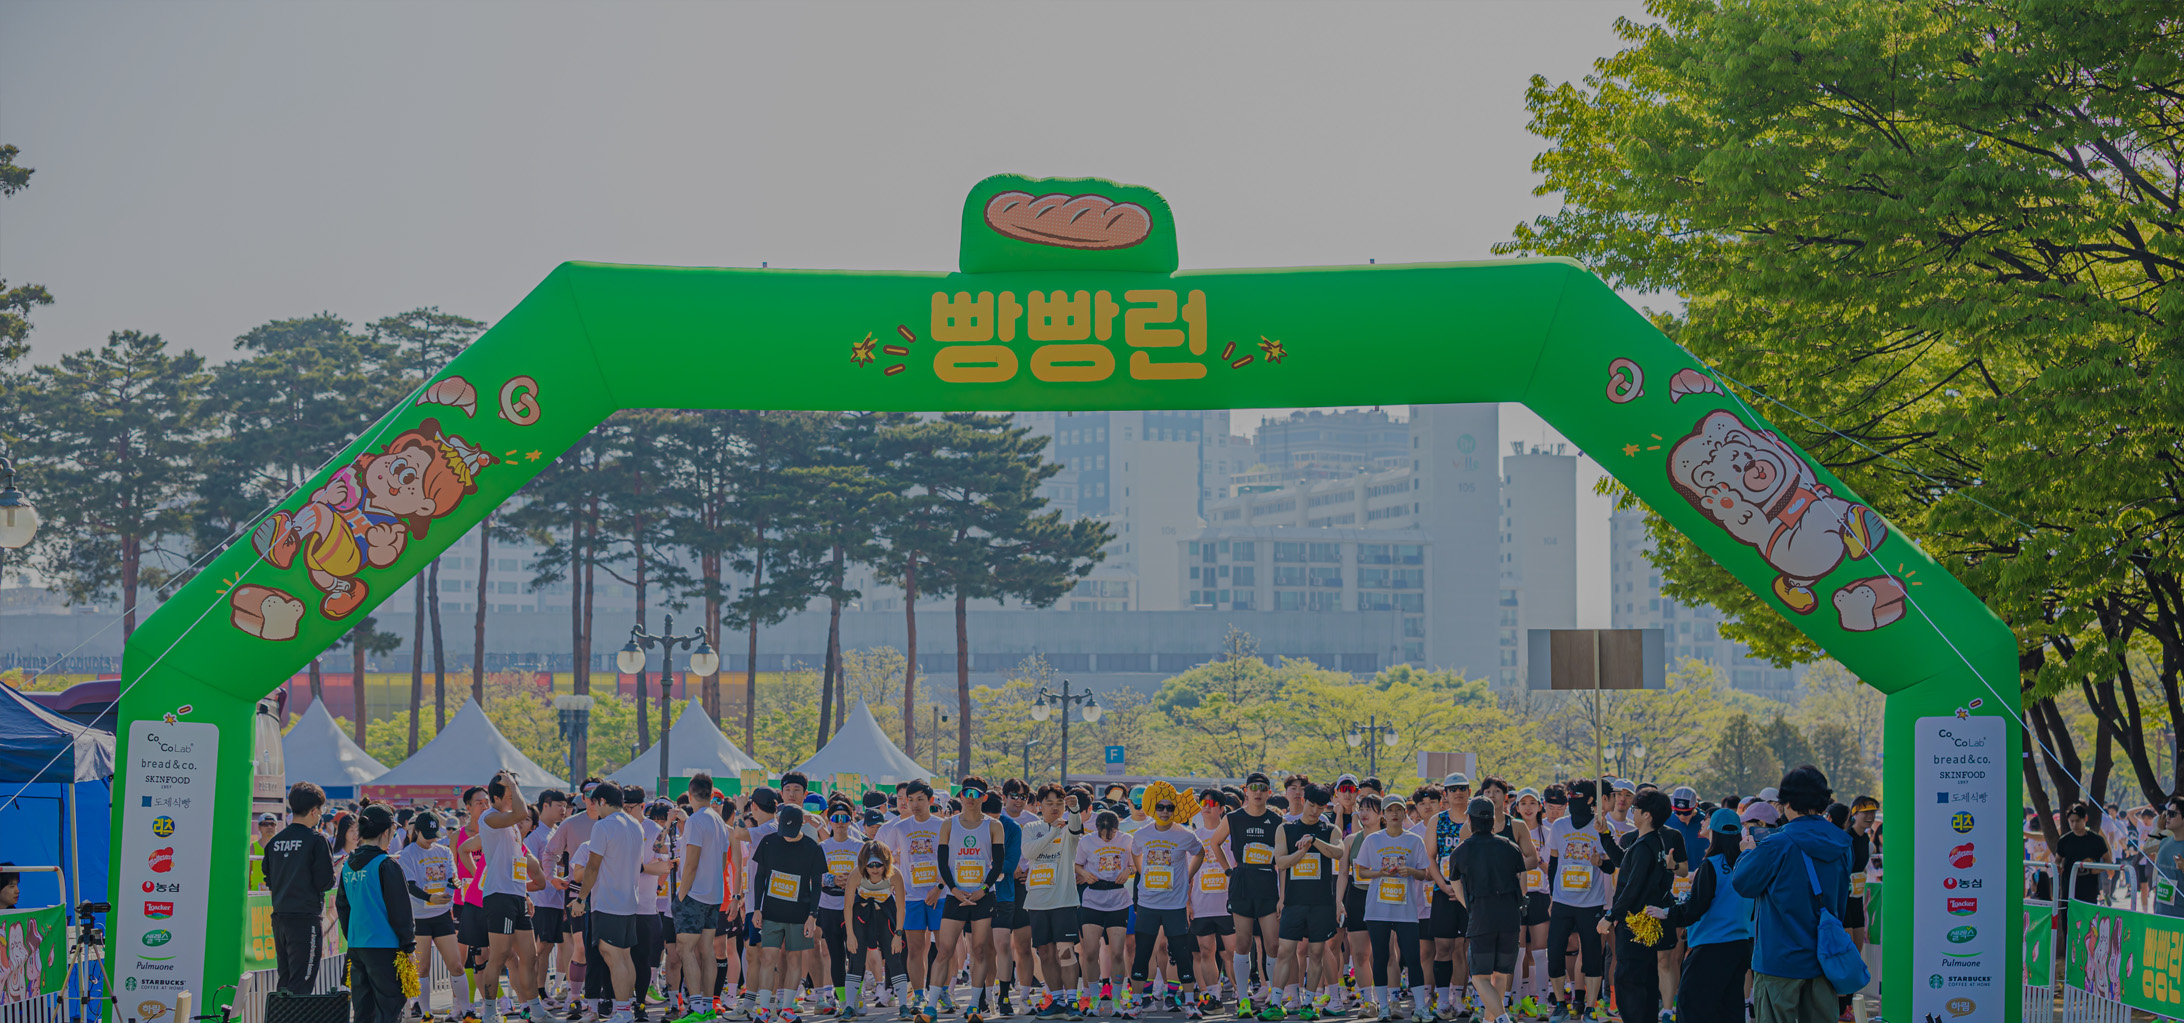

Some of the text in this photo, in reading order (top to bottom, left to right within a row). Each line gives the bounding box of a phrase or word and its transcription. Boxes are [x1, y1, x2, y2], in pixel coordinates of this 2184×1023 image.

[931, 288, 1207, 383] 빵빵런
[1111, 749, 1118, 760] F
[145, 775, 191, 784] SKINFOOD
[1939, 771, 1986, 779] SKINFOOD
[154, 797, 191, 809] 도제식빵
[1951, 792, 1988, 804] 도제식빵
[153, 818, 174, 835] 리츠
[1952, 813, 1974, 831] 리츠
[273, 840, 302, 852] STAFF
[957, 847, 981, 856] JUDY
[344, 870, 367, 883] STAFF
[914, 870, 935, 878] A1276
[960, 869, 980, 877] A1173
[156, 882, 180, 893] 농심
[773, 881, 794, 891] A1262
[1959, 878, 1982, 888] 농심
[146, 903, 171, 911] Loacker
[1950, 900, 1975, 908] Loacker
[145, 933, 169, 944] 셀렉스
[1950, 929, 1975, 941] 셀렉스
[136, 961, 174, 971] Pulmuone
[1941, 959, 1981, 967] Pulmuone
[2142, 927, 2184, 1004] 빵빵런
[142, 1004, 161, 1015] 하림
[1951, 1001, 1970, 1012] 하림
